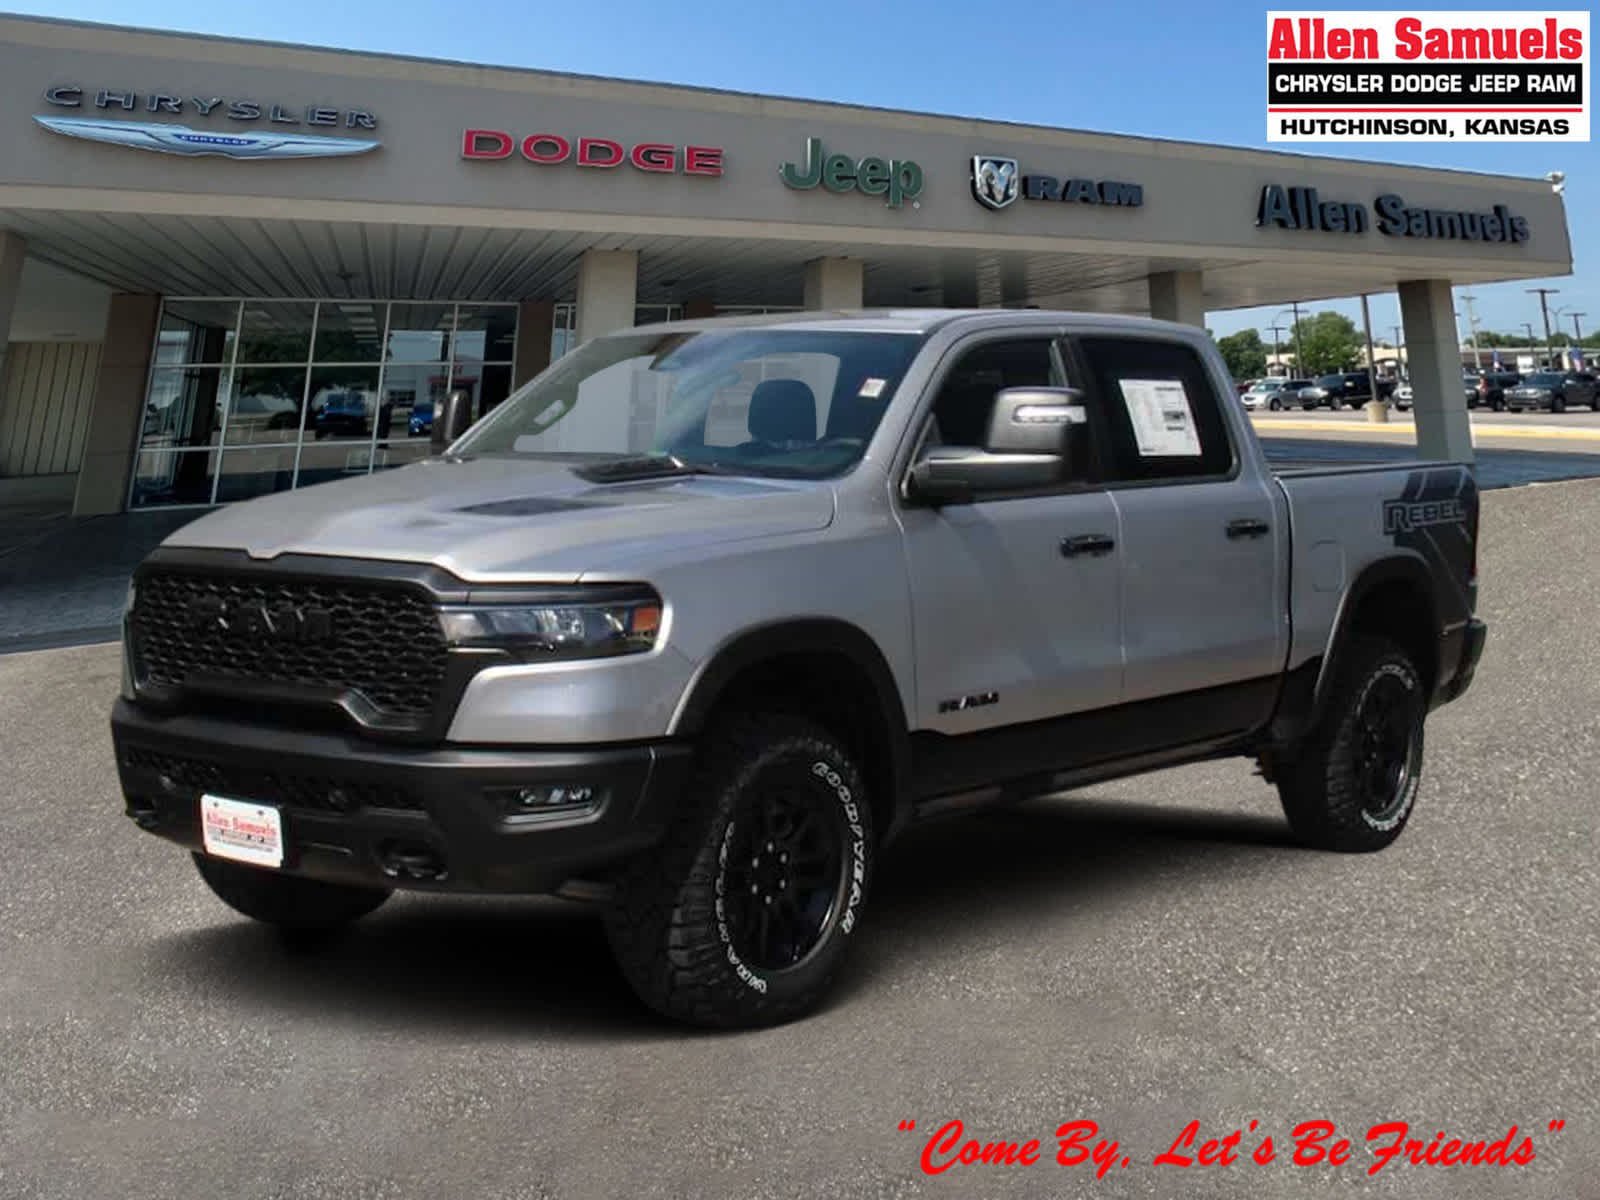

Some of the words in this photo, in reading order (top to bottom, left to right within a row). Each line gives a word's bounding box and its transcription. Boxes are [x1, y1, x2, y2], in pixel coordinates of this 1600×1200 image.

[43, 86, 378, 129] CHRYSLER
[461, 129, 724, 176] DODGE
[779, 136, 924, 209] Jeep
[1023, 175, 1144, 207] RAM
[1256, 184, 1369, 234] Allen
[1375, 195, 1531, 243] Samuels
[1383, 500, 1466, 534] REBEL
